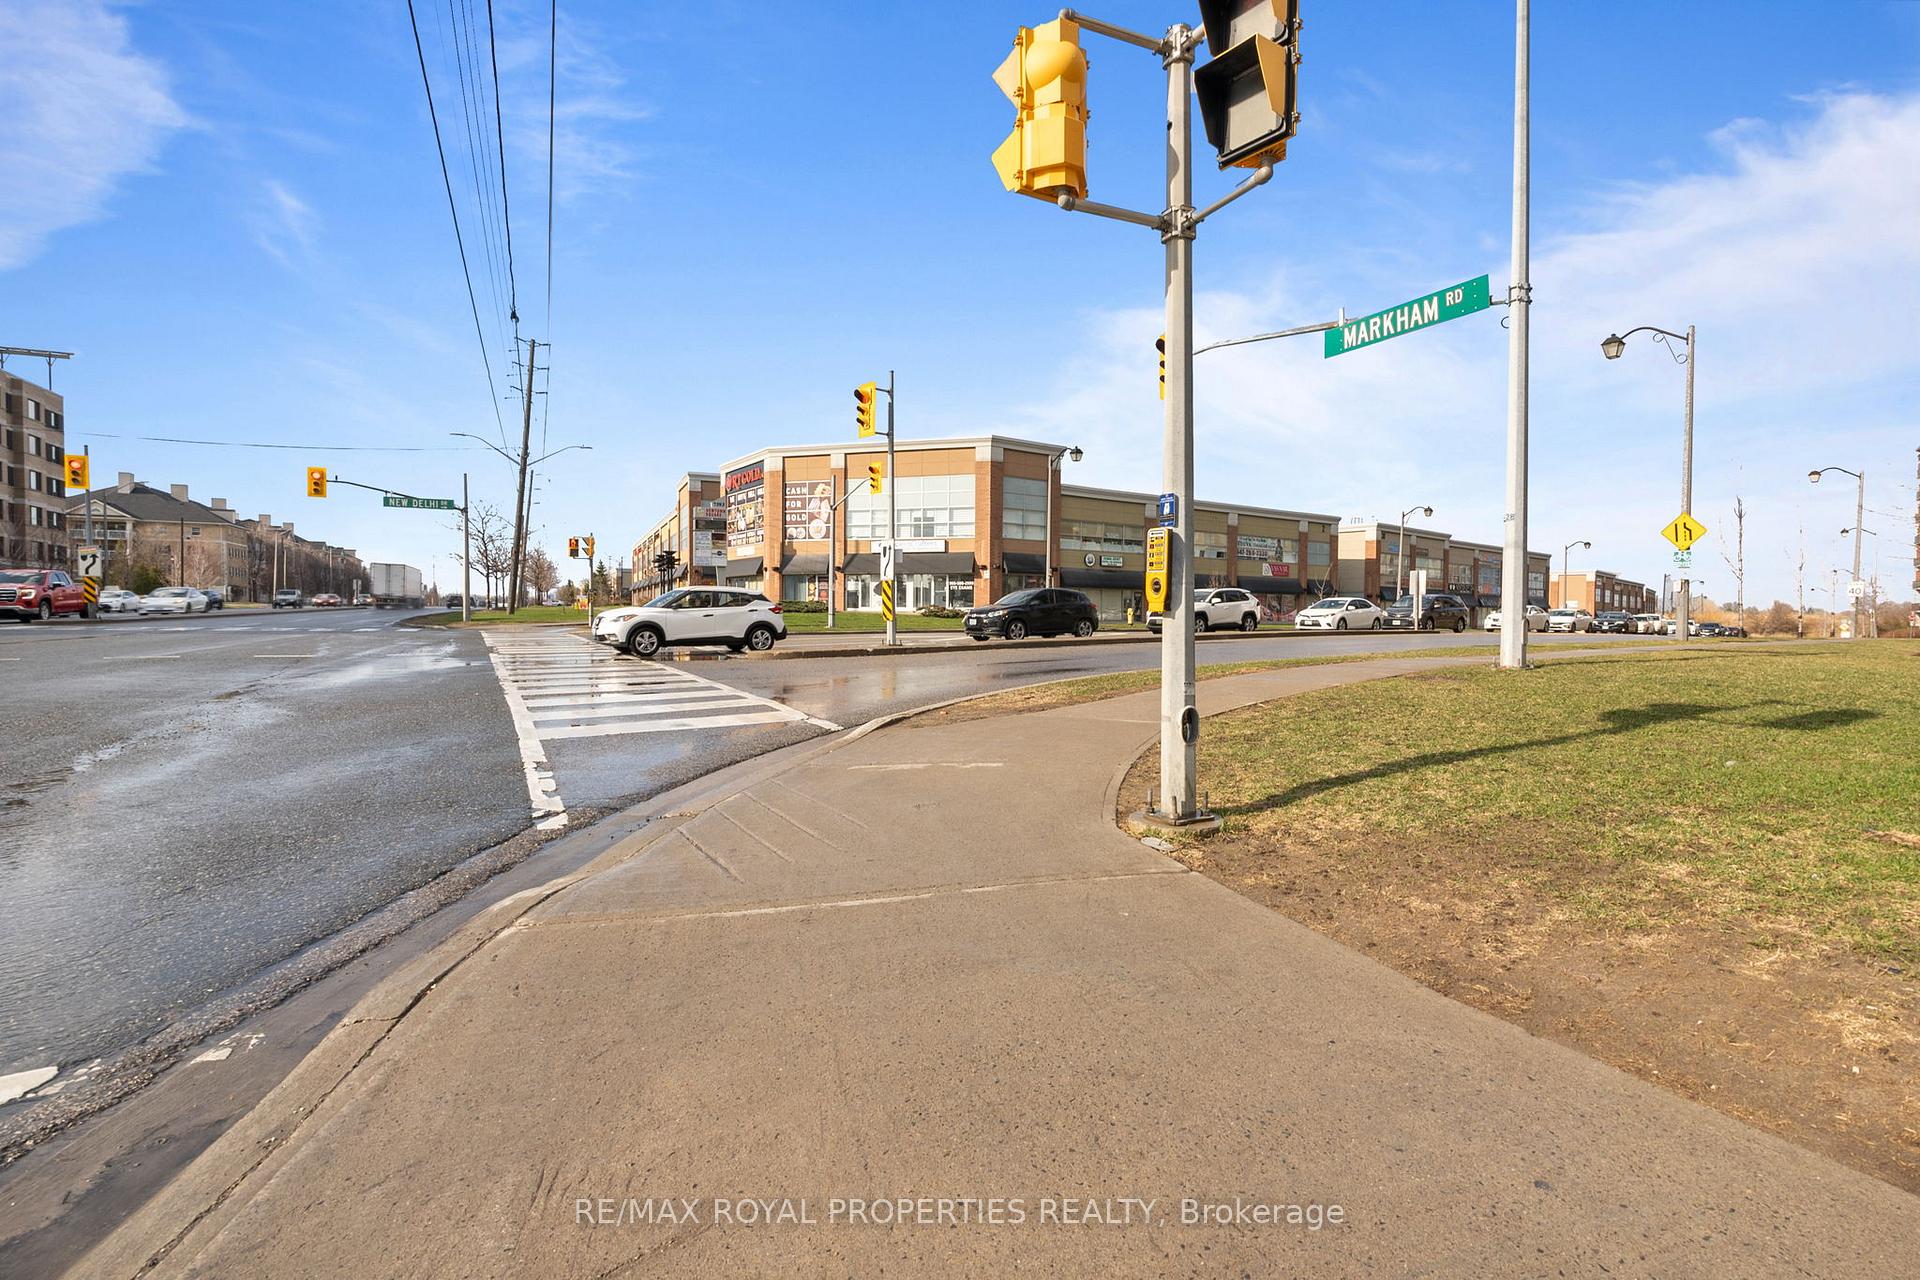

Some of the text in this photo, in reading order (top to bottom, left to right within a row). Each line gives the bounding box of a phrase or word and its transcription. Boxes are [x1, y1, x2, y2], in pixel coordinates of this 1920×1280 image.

[1343, 288, 1463, 349] MARKHAM RD
[786, 487, 807, 495] CASH
[389, 498, 408, 507] NEW
[412, 499, 439, 508] DELHI
[786, 500, 801, 508] FOR
[786, 513, 807, 521] GOLD
